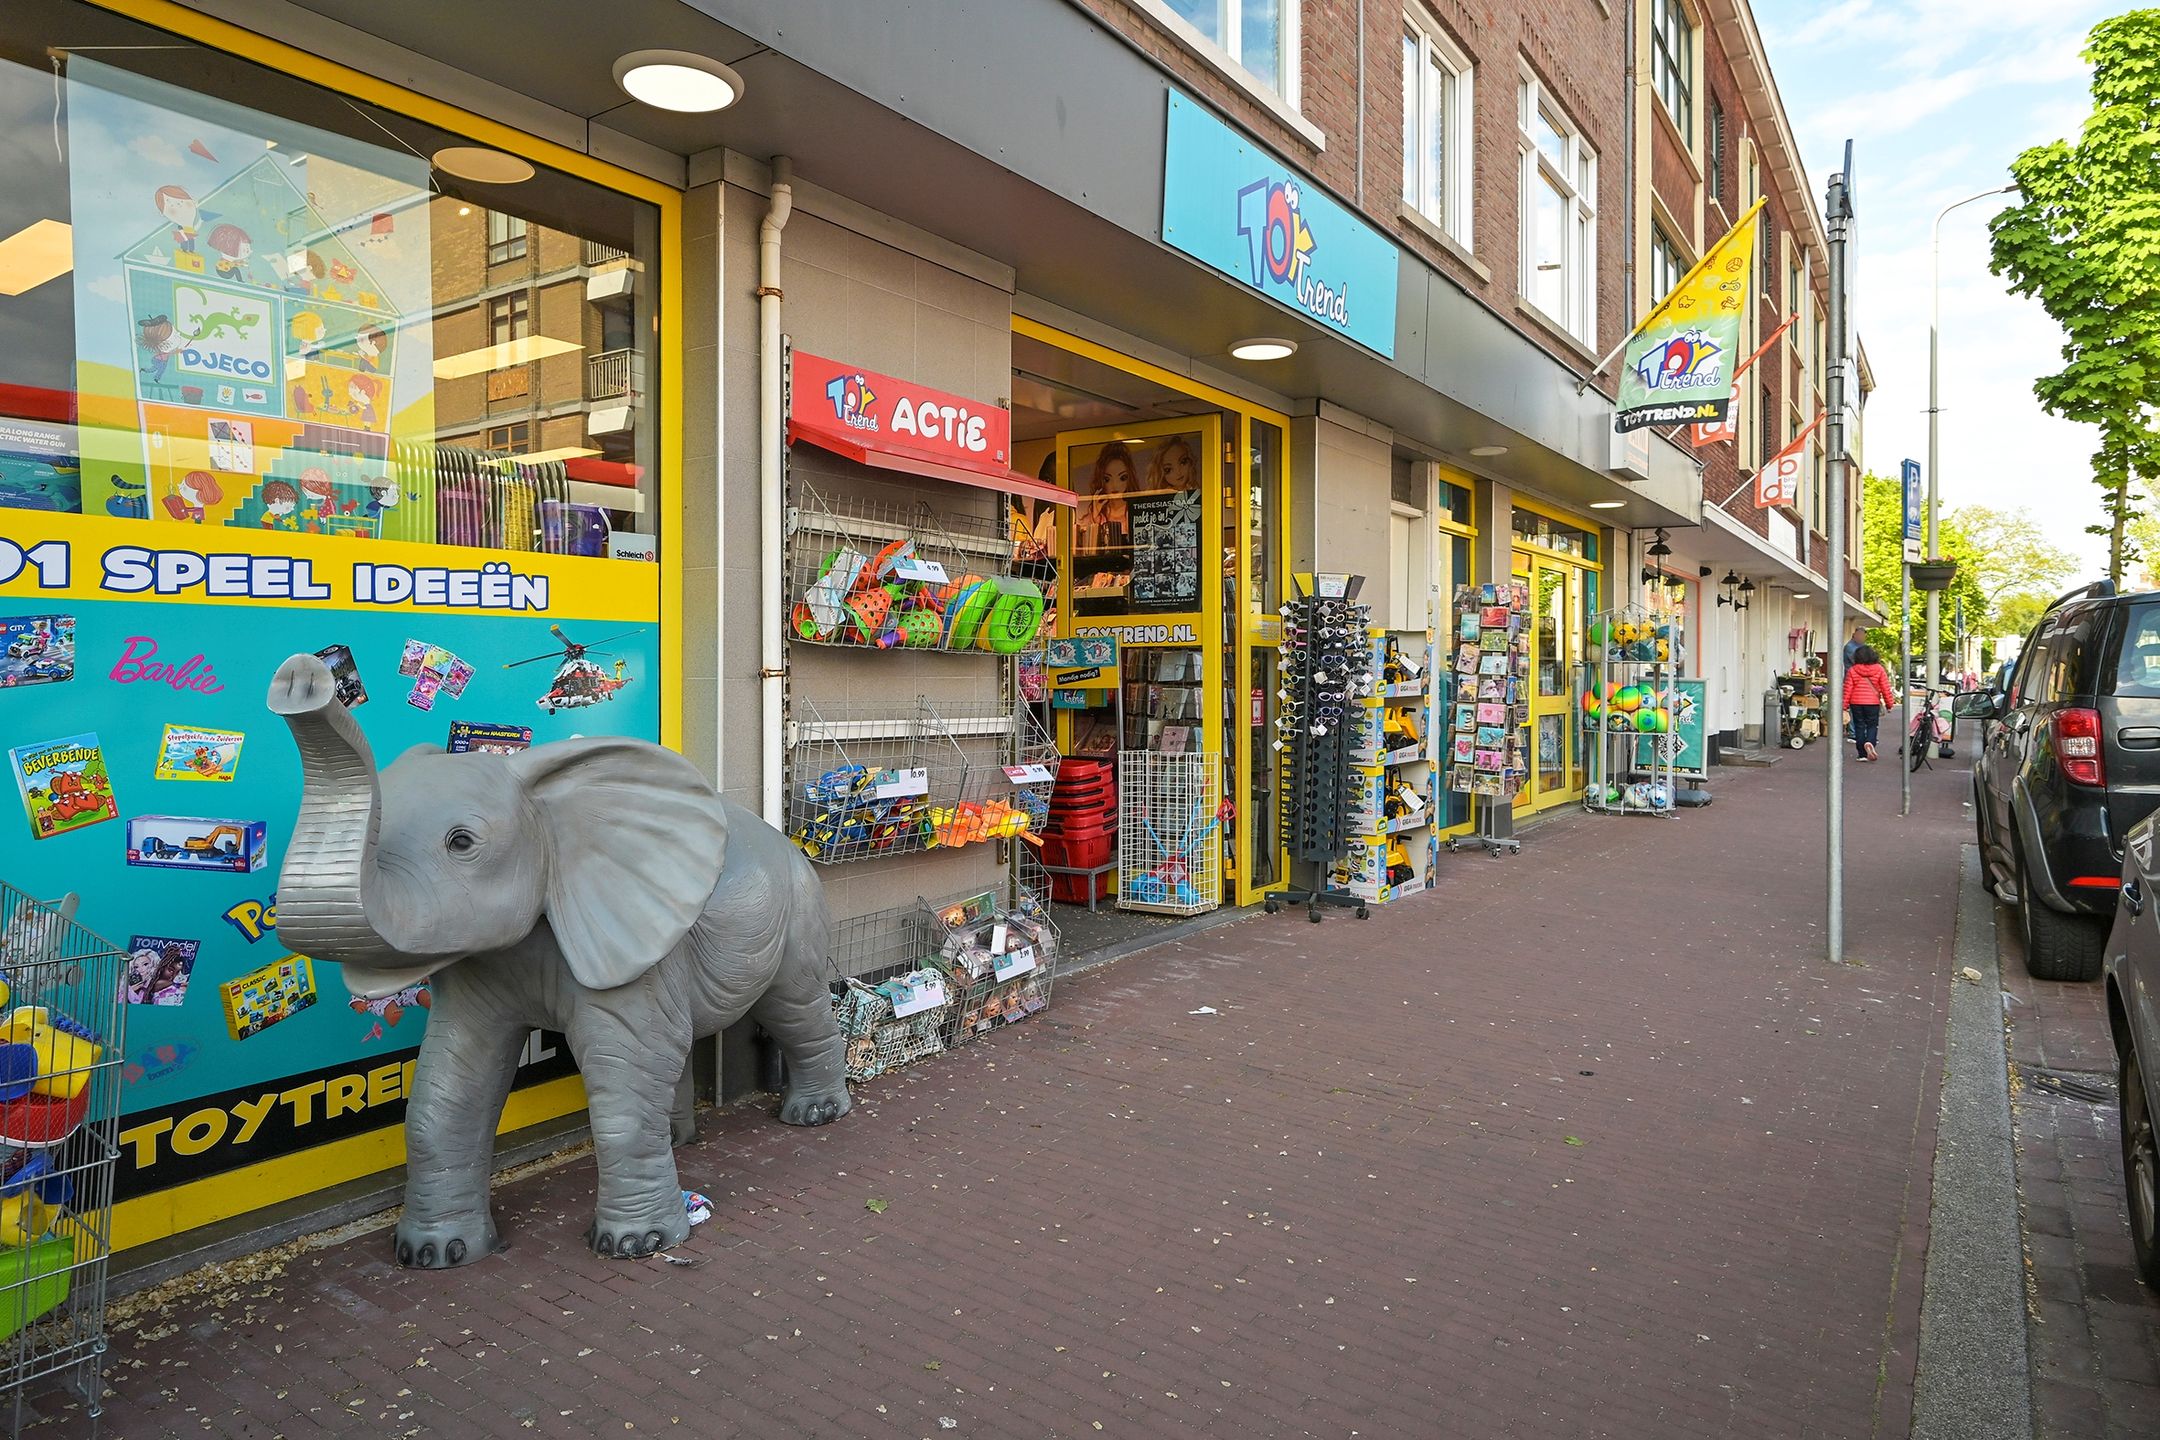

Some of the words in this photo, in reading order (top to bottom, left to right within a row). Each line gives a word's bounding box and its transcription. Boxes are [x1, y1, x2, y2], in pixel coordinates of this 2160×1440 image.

[1237, 174, 1318, 289] TOY
[1296, 250, 1349, 327] Trend
[182, 348, 271, 379] DJECO
[1637, 335, 1722, 389] TOY
[1659, 367, 1720, 389] Trend
[826, 374, 878, 419] TOY
[843, 404, 879, 432] Trend
[1622, 403, 1719, 428] TOYTREND.NL
[12, 429, 33, 437] LONG
[34, 432, 61, 441] RANGE
[22, 437, 49, 446] WATER
[616, 549, 645, 559] Schleich
[99, 545, 331, 600] SPEEL
[353, 561, 549, 611] IDEEËN
[109, 636, 225, 695] Barbie
[22, 747, 100, 776] BEVERBENDE
[135, 936, 199, 952] TOPModel
[241, 974, 267, 990] CLASSIC
